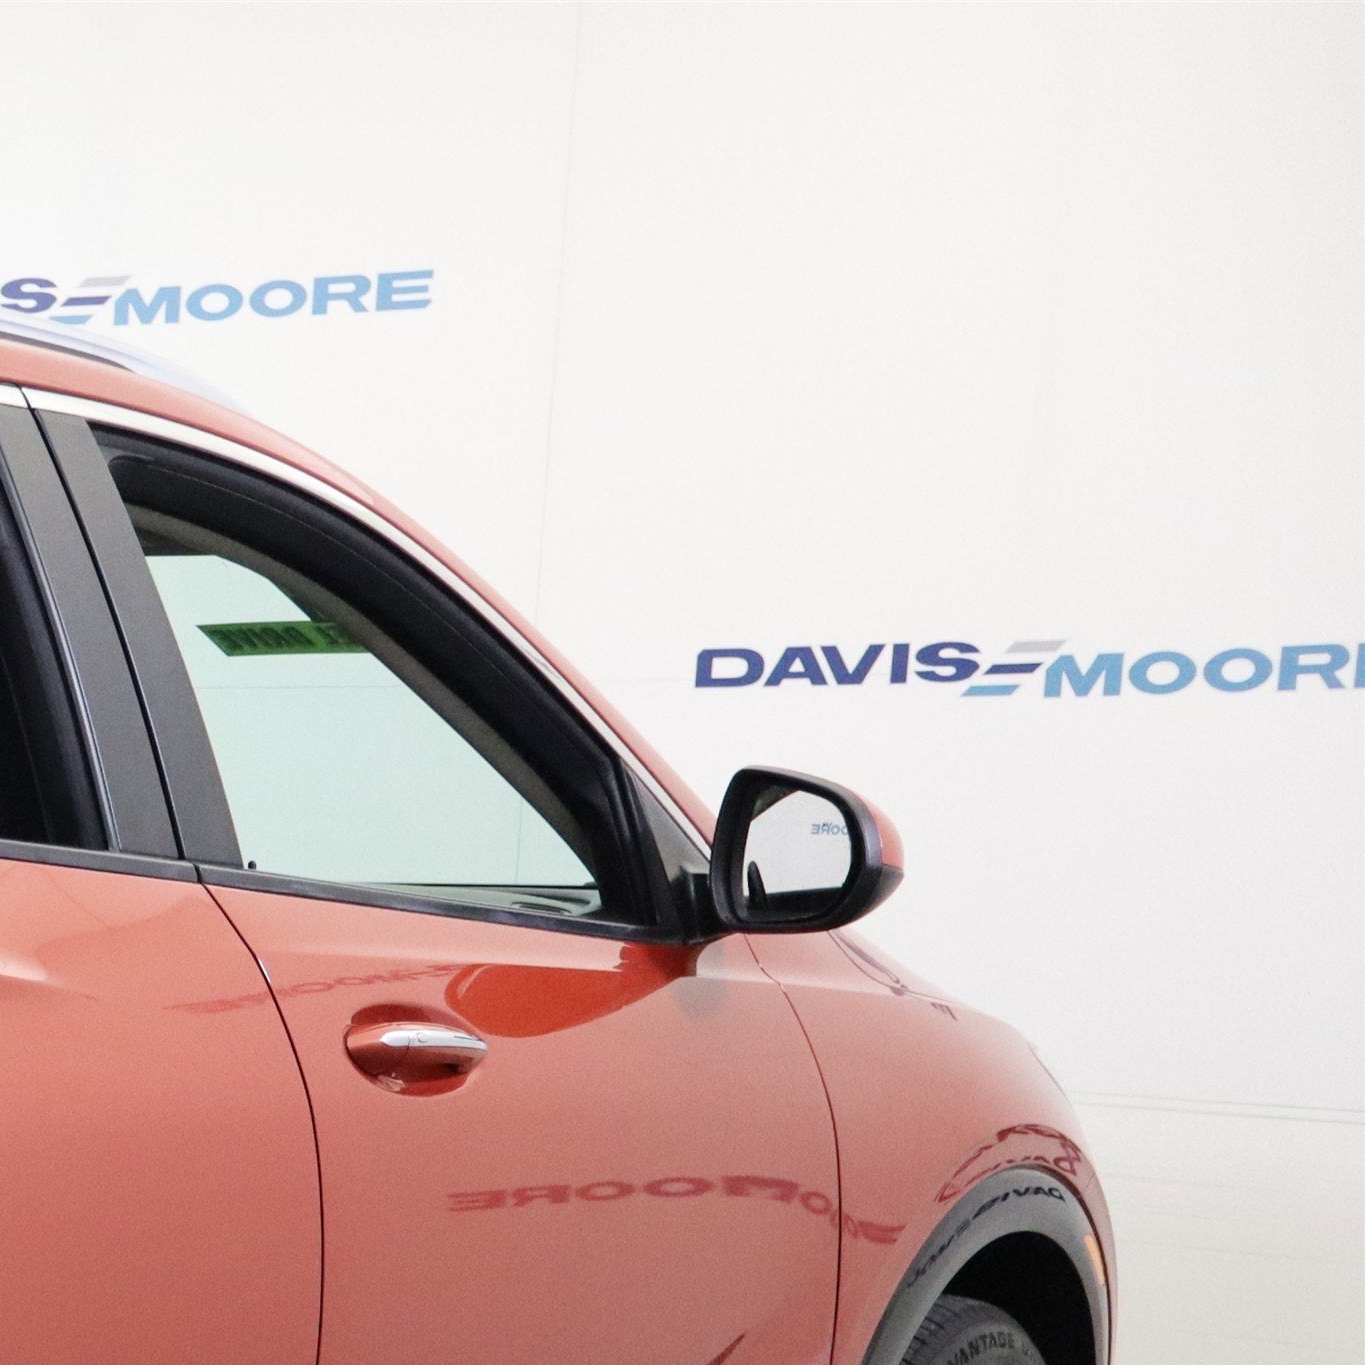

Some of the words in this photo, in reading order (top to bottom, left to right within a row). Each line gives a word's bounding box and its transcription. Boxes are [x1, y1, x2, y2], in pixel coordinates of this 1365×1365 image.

[113, 268, 434, 326] MOORE
[694, 640, 982, 689] DAVIS
[1043, 642, 1365, 698] MOOR
